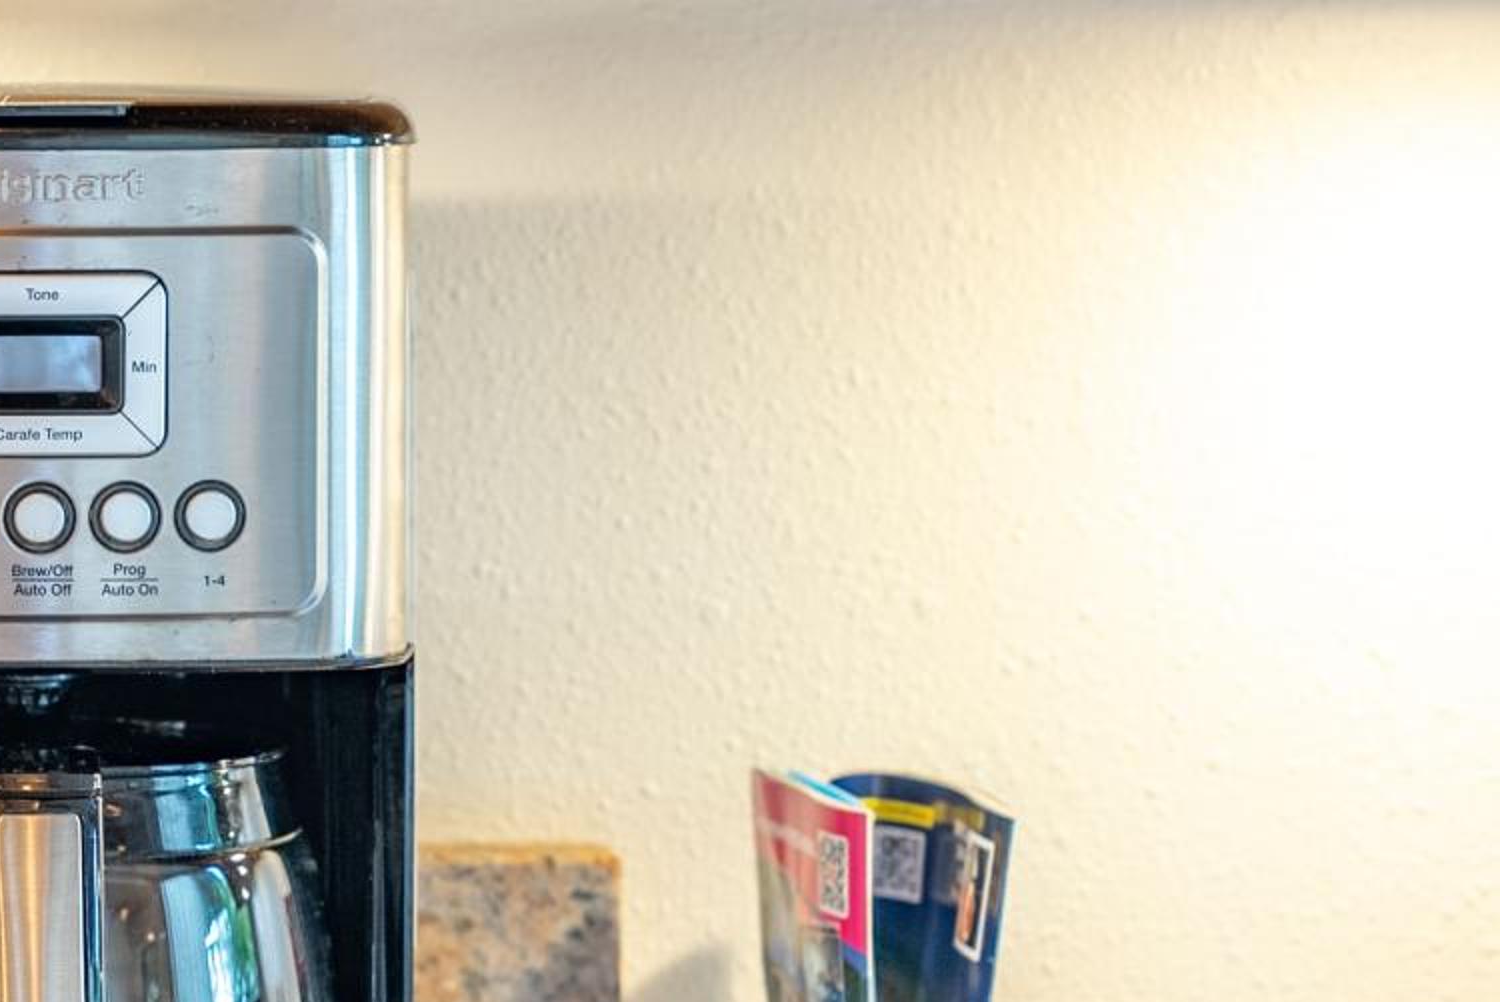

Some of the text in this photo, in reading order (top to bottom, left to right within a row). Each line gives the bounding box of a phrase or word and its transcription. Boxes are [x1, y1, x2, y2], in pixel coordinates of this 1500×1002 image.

[25, 288, 59, 301] Tone
[132, 360, 157, 373] Min
[46, 428, 83, 443] Temp
[11, 564, 74, 577] Brew/Off
[113, 563, 145, 578] Prog
[204, 575, 225, 587] 1-4
[13, 583, 72, 597] Auto Off
[102, 584, 159, 597] Auto On
